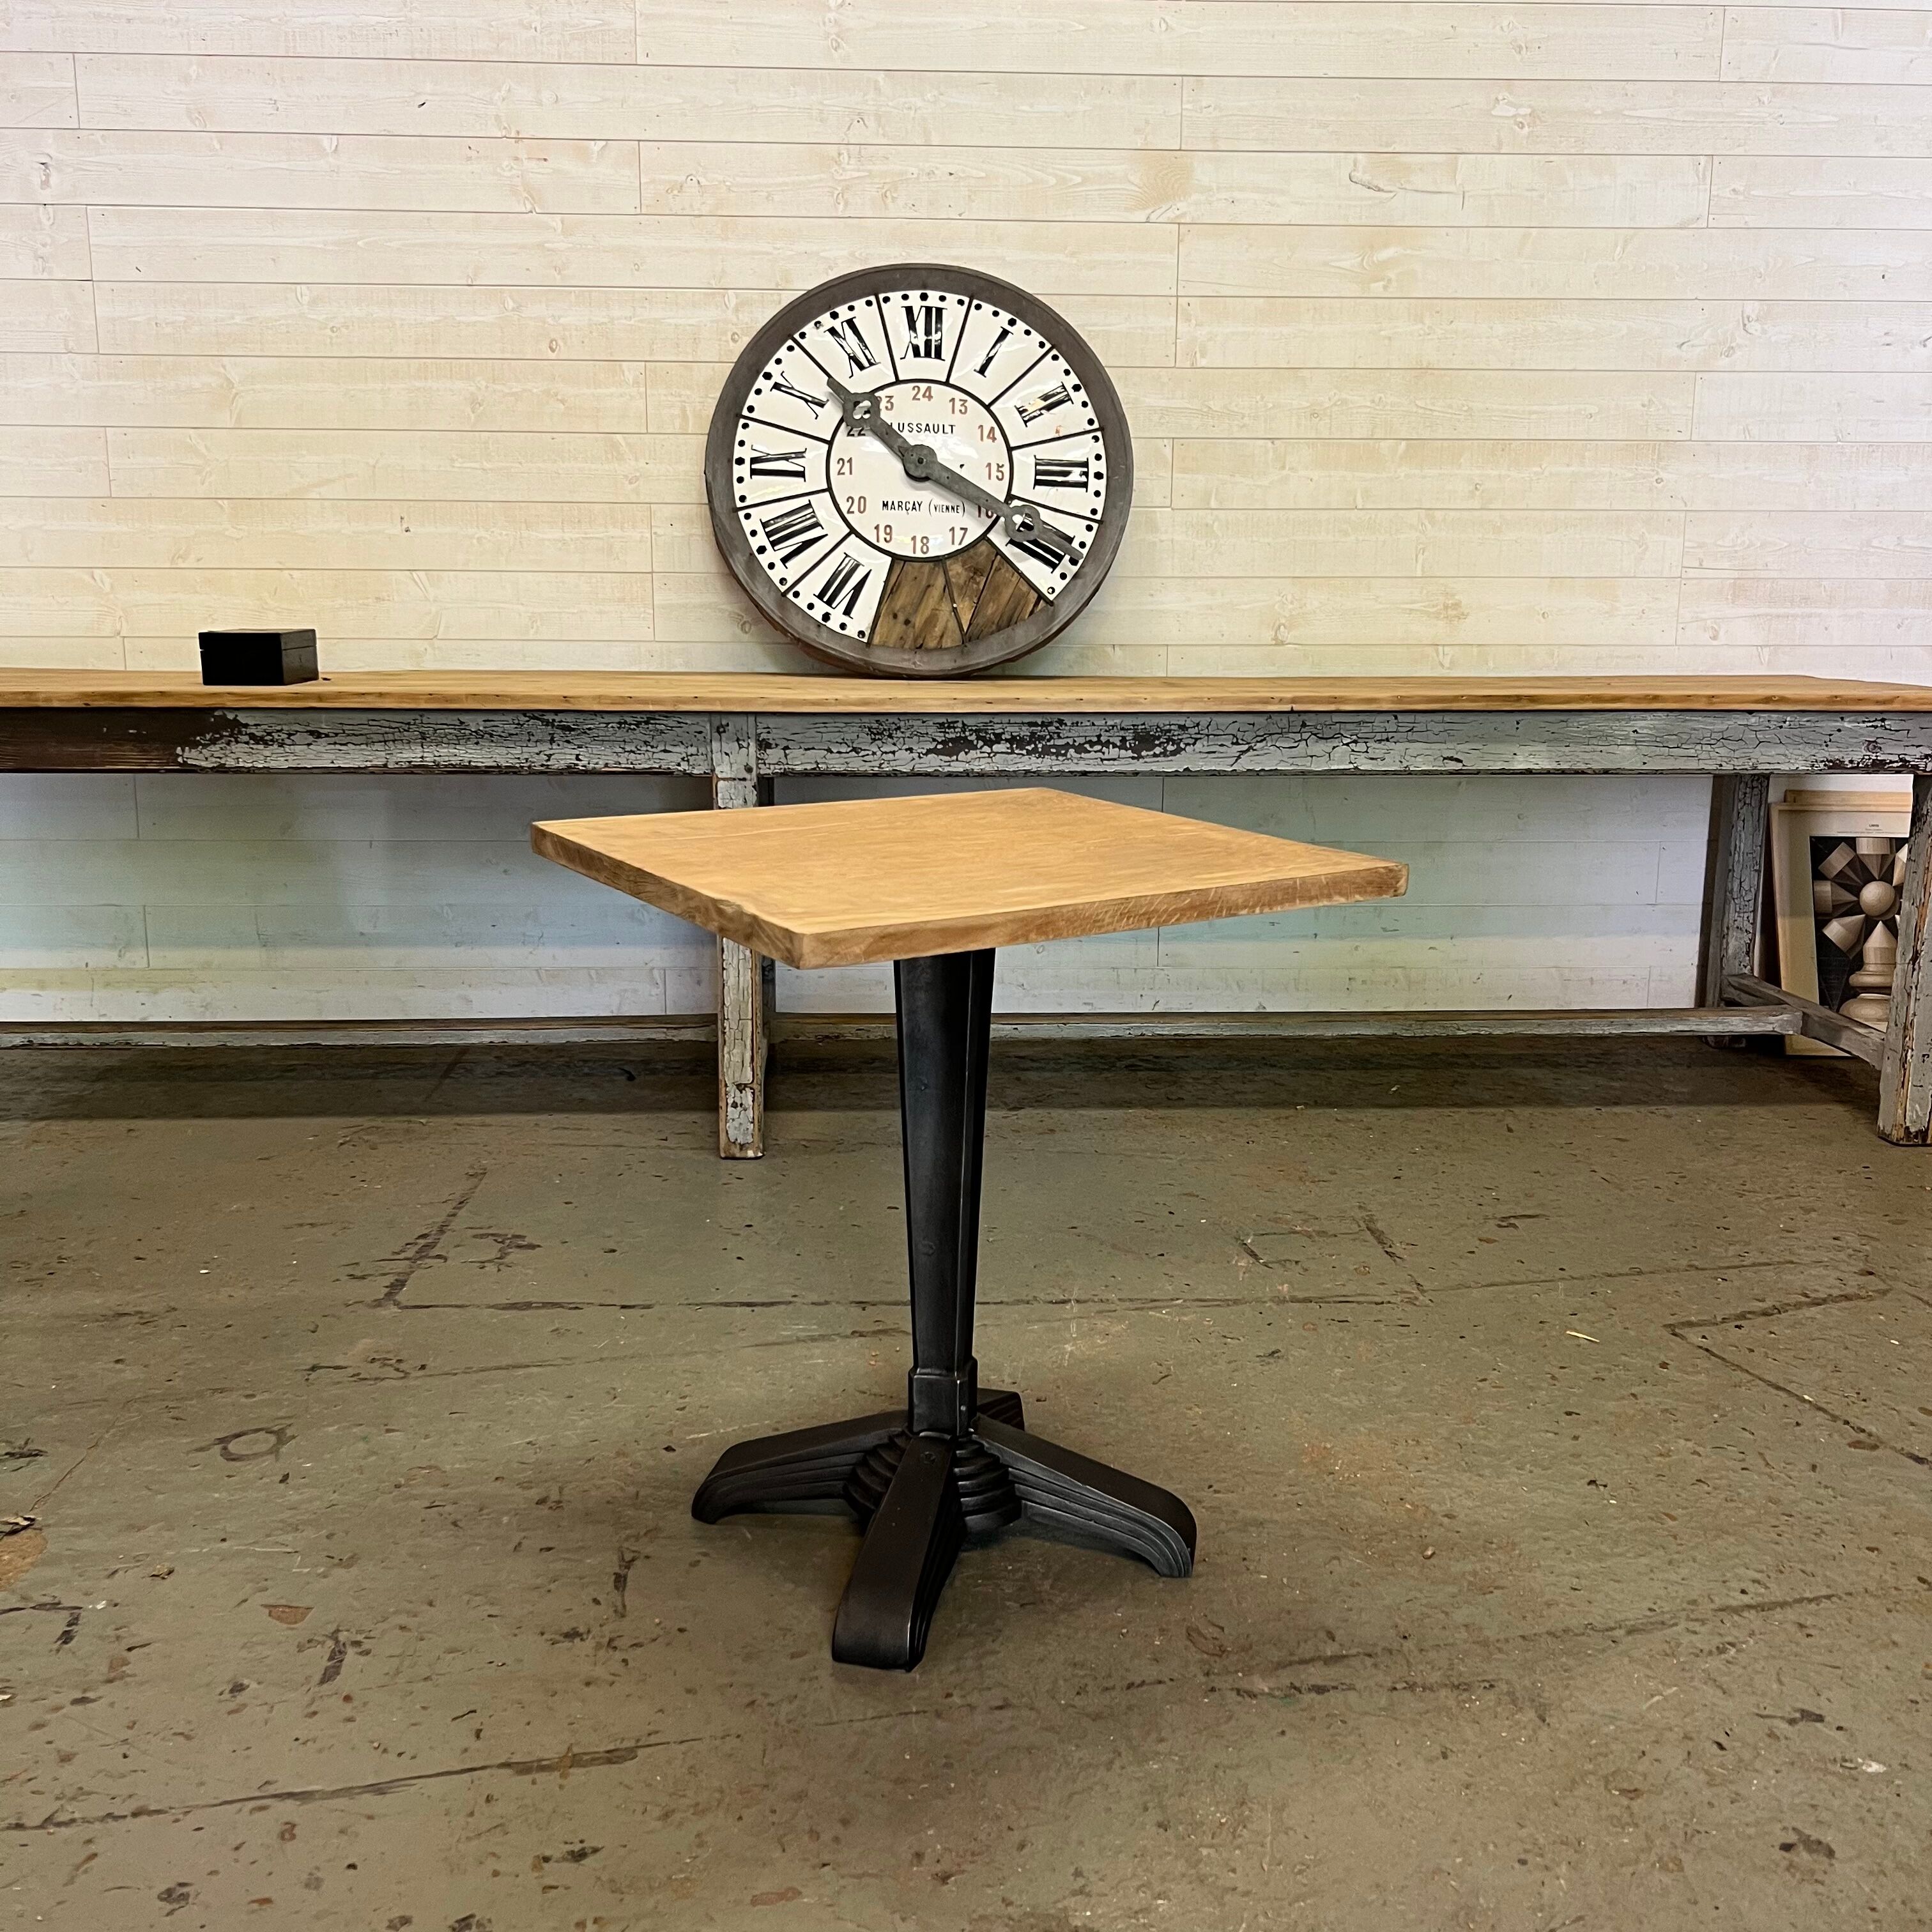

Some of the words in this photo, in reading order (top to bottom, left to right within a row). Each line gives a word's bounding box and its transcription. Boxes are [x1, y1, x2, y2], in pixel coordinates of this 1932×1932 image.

[900, 305, 947, 362] XII
[823, 316, 882, 378] XI
[973, 326, 1014, 378] I
[770, 371, 829, 420] X
[912, 385, 933, 401] 24
[877, 395, 894, 411] 3
[949, 397, 968, 415] 13
[977, 424, 997, 443] 14
[836, 457, 854, 476] 21
[985, 462, 1005, 481] 15
[1032, 455, 1089, 493] III
[846, 496, 867, 514] 20
[882, 500, 923, 515] MARÇAY
[928, 498, 965, 518] (VIENNE)
[874, 524, 893, 543] 19
[949, 526, 968, 546] 17
[910, 535, 930, 555] 18
